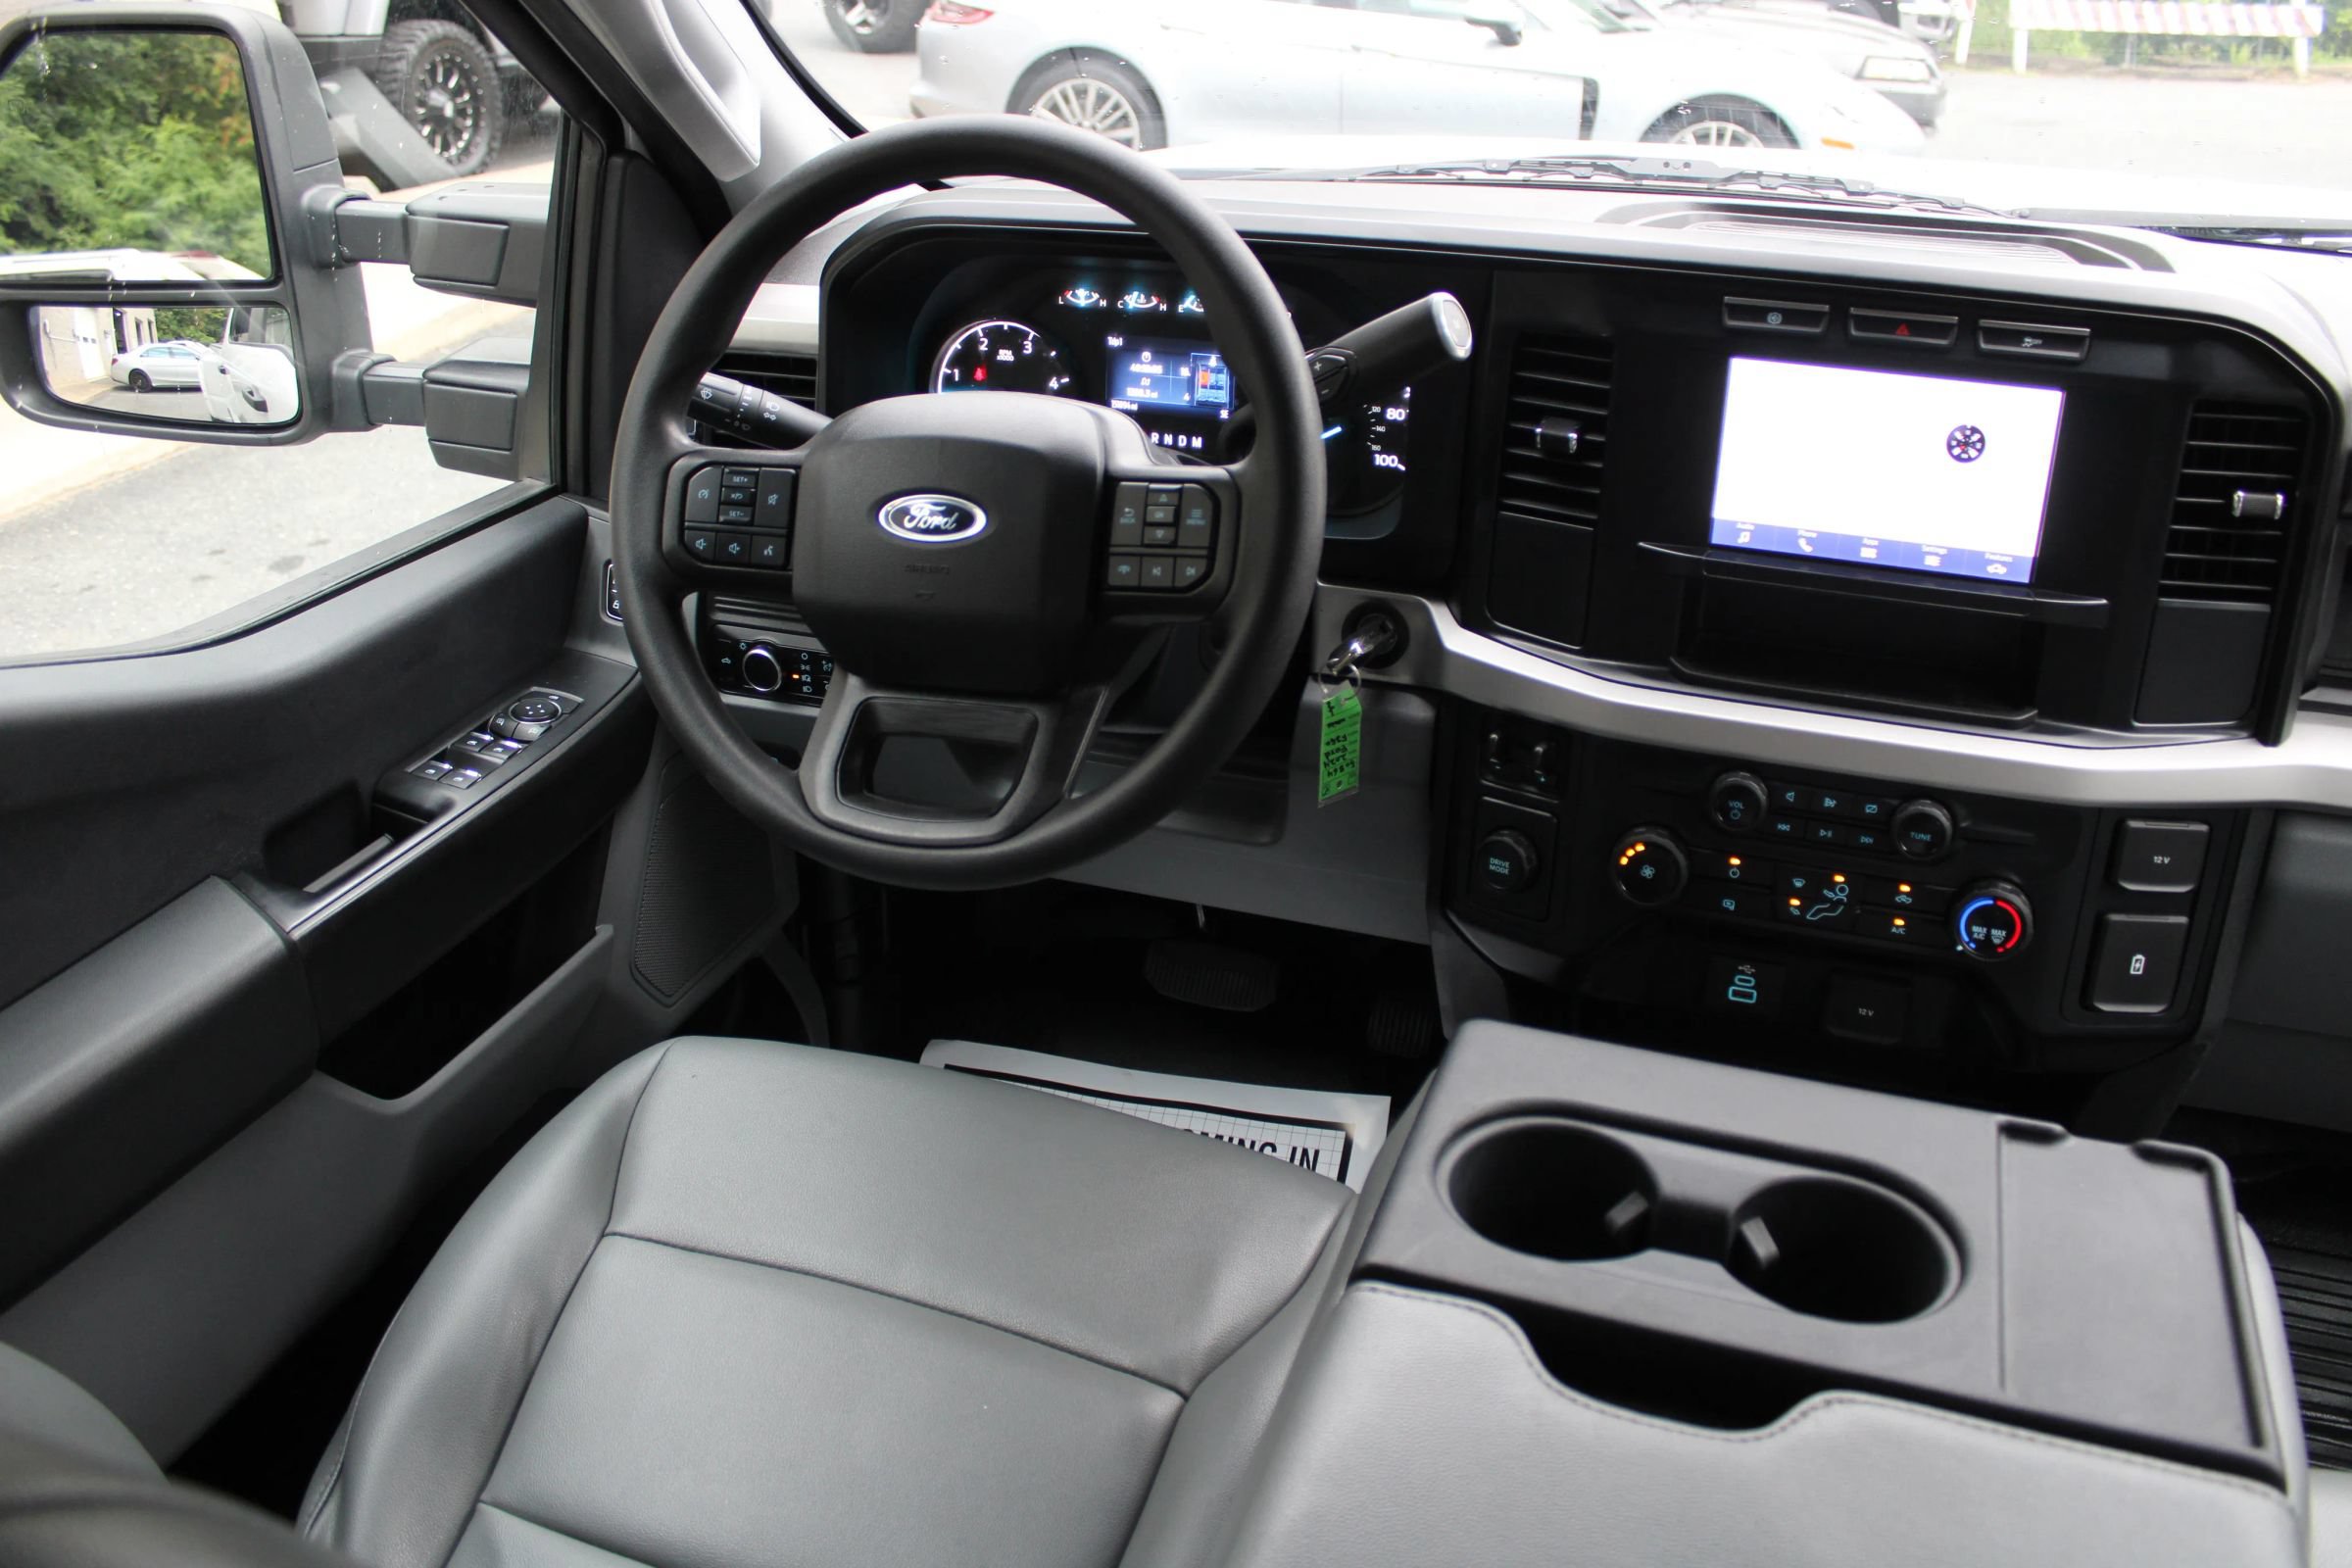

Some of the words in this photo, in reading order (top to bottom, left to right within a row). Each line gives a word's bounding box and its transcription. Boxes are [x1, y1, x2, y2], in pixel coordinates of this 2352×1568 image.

[1117, 300, 1123, 309] C
[1160, 303, 1167, 312] H
[980, 337, 989, 351] 2
[1023, 340, 1033, 355] 3
[953, 368, 959, 382] 1
[1049, 376, 1059, 390] 4
[1385, 407, 1406, 421] 80
[1151, 431, 1160, 445] R
[1163, 433, 1173, 446] N
[1178, 434, 1187, 447] D
[1192, 436, 1202, 449] M
[1374, 454, 1398, 467] 100
[904, 502, 958, 530] Ford
[1729, 800, 1744, 809] VOL
[1910, 831, 1933, 842] TUNE
[1490, 858, 1510, 868] DRIVE
[2153, 856, 2163, 864] 12
[2164, 856, 2171, 864] V
[1490, 863, 1510, 875] MODE
[1890, 926, 1906, 935] A/C
